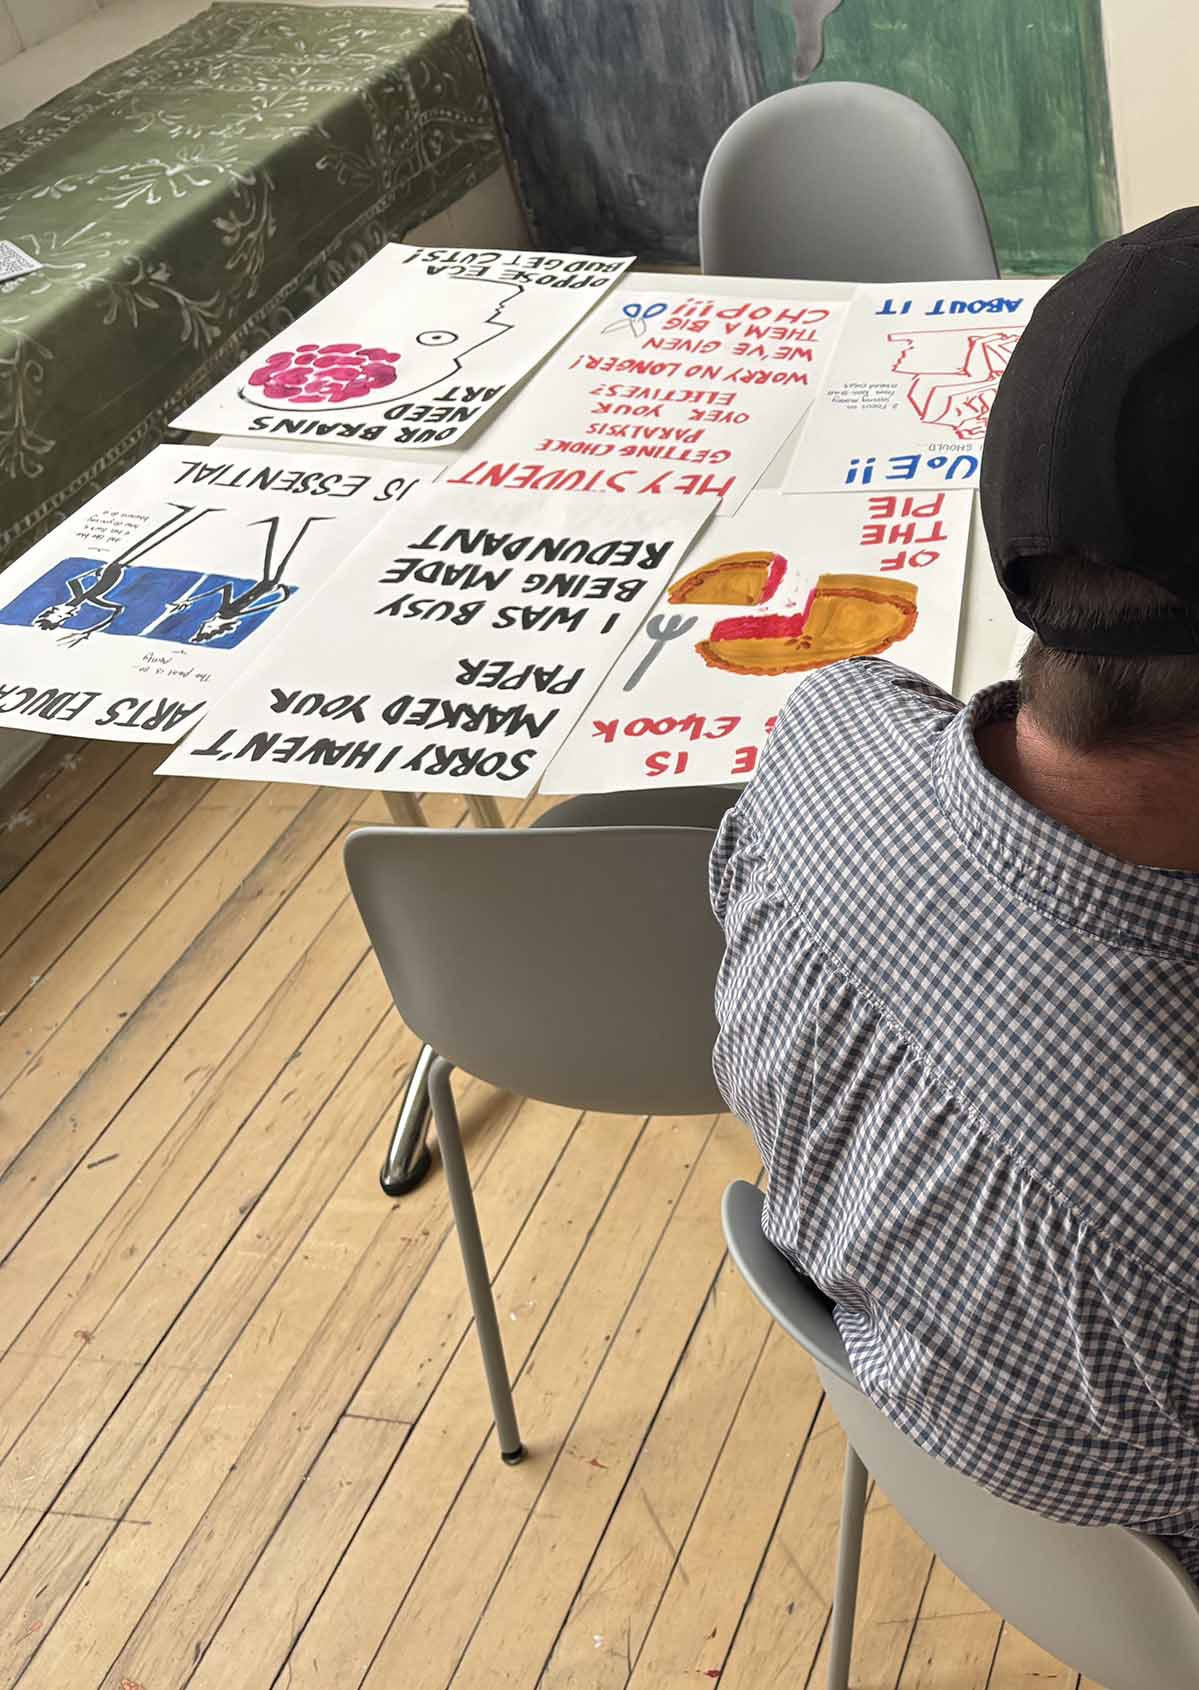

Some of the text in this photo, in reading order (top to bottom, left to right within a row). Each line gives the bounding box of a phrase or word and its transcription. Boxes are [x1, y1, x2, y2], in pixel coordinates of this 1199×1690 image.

[403, 249, 625, 273] BUDGET CUTS!
[426, 264, 609, 290] OPPOSE ECA
[875, 297, 1024, 316] ABOUT IT
[662, 316, 818, 342] THEM A BIG
[642, 336, 721, 353] GIVEN
[569, 354, 809, 385] WORRY NO LONGER!
[433, 385, 506, 402] ART
[384, 404, 482, 422] NEED
[591, 401, 749, 424] OVER YOUR
[249, 416, 458, 444] OUR BRAINS
[586, 423, 704, 443] PARALYSIS
[618, 445, 732, 464] GETTING
[173, 460, 419, 501] IS ESSENTIAL
[866, 493, 945, 519] PIE
[860, 520, 947, 546] THE
[408, 524, 674, 570] REDUNDANT
[880, 549, 940, 572] OF
[379, 556, 648, 602] BEING MADE
[374, 593, 622, 634] I WAS BUSY
[456, 658, 585, 694] PAPER
[96, 698, 207, 732] ARTS
[271, 687, 560, 739] MARKED YOUR
[191, 728, 537, 781] SORRY I HAVEN'T
[645, 751, 689, 776] IS
